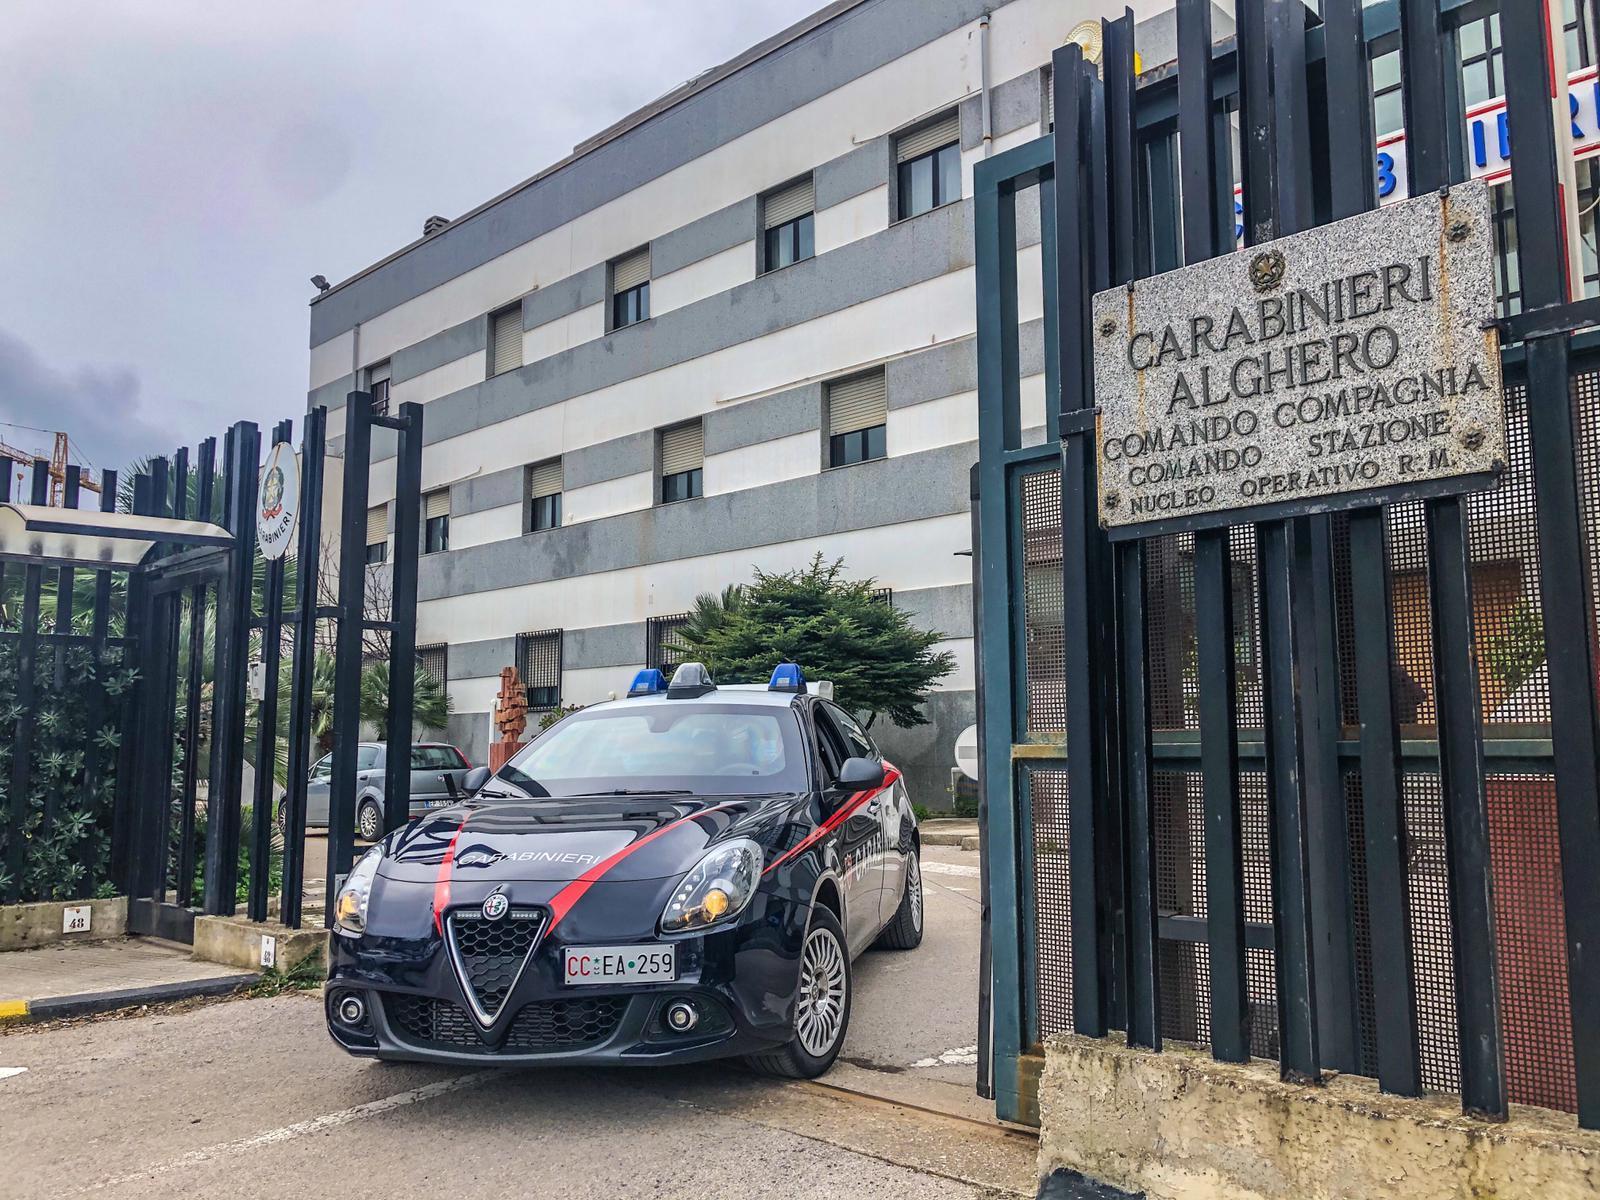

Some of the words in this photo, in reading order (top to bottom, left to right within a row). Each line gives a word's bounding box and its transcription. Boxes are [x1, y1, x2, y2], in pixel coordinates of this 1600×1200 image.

[1127, 256, 1433, 371] CARABINIERI
[1166, 325, 1400, 415] ALGHERO
[1103, 410, 1258, 461] COMANDO
[1274, 362, 1490, 428] COMPAGNIA
[1128, 445, 1262, 488] COMANDO
[1307, 410, 1452, 457] STAZIONE
[1130, 486, 1215, 515] NUCLEO
[1240, 460, 1380, 497] OPERATIVO
[458, 851, 601, 865] CARABINIERI
[69, 917, 85, 929] 48
[567, 956, 591, 976] CC
[603, 955, 626, 975] EA
[637, 953, 673, 975] 259
